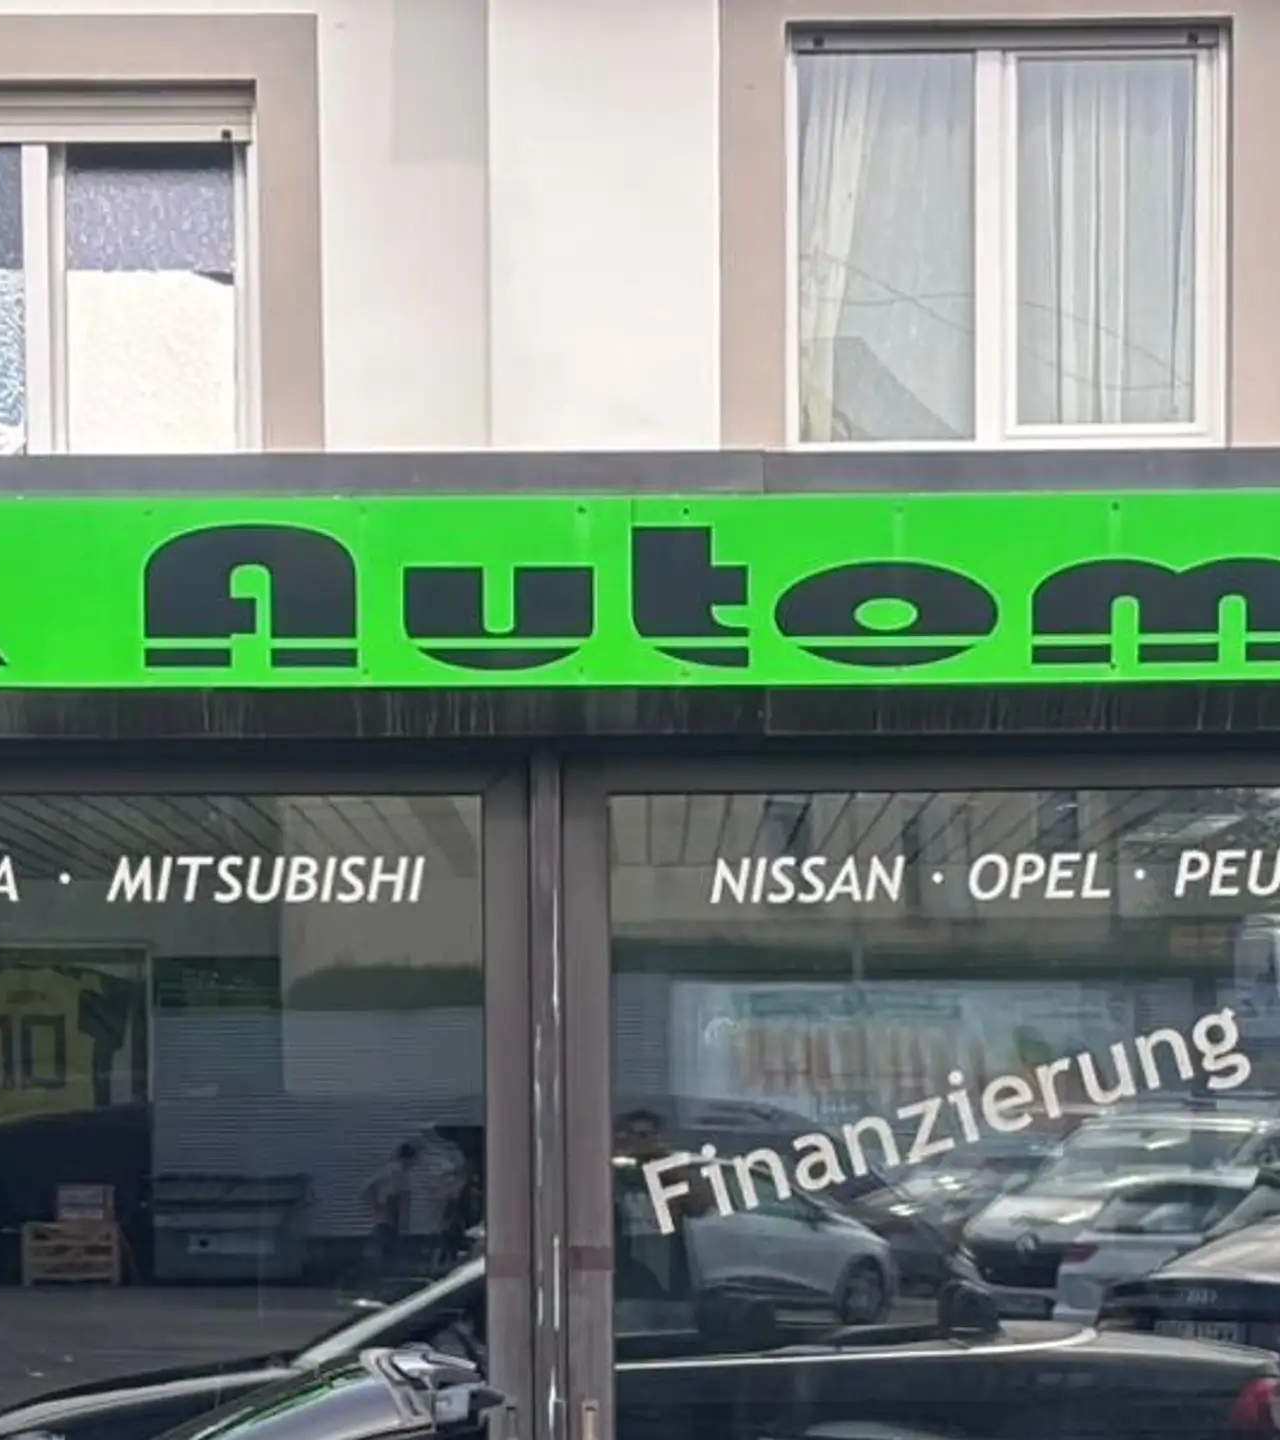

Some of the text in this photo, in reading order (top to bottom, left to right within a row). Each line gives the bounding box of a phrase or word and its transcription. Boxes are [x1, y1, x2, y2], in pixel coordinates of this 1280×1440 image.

[106, 854, 427, 904] MITSUBISHI
[709, 853, 907, 905] NISSAN
[967, 850, 1112, 902] OPEL
[641, 1006, 1253, 1235] Finanzierung
